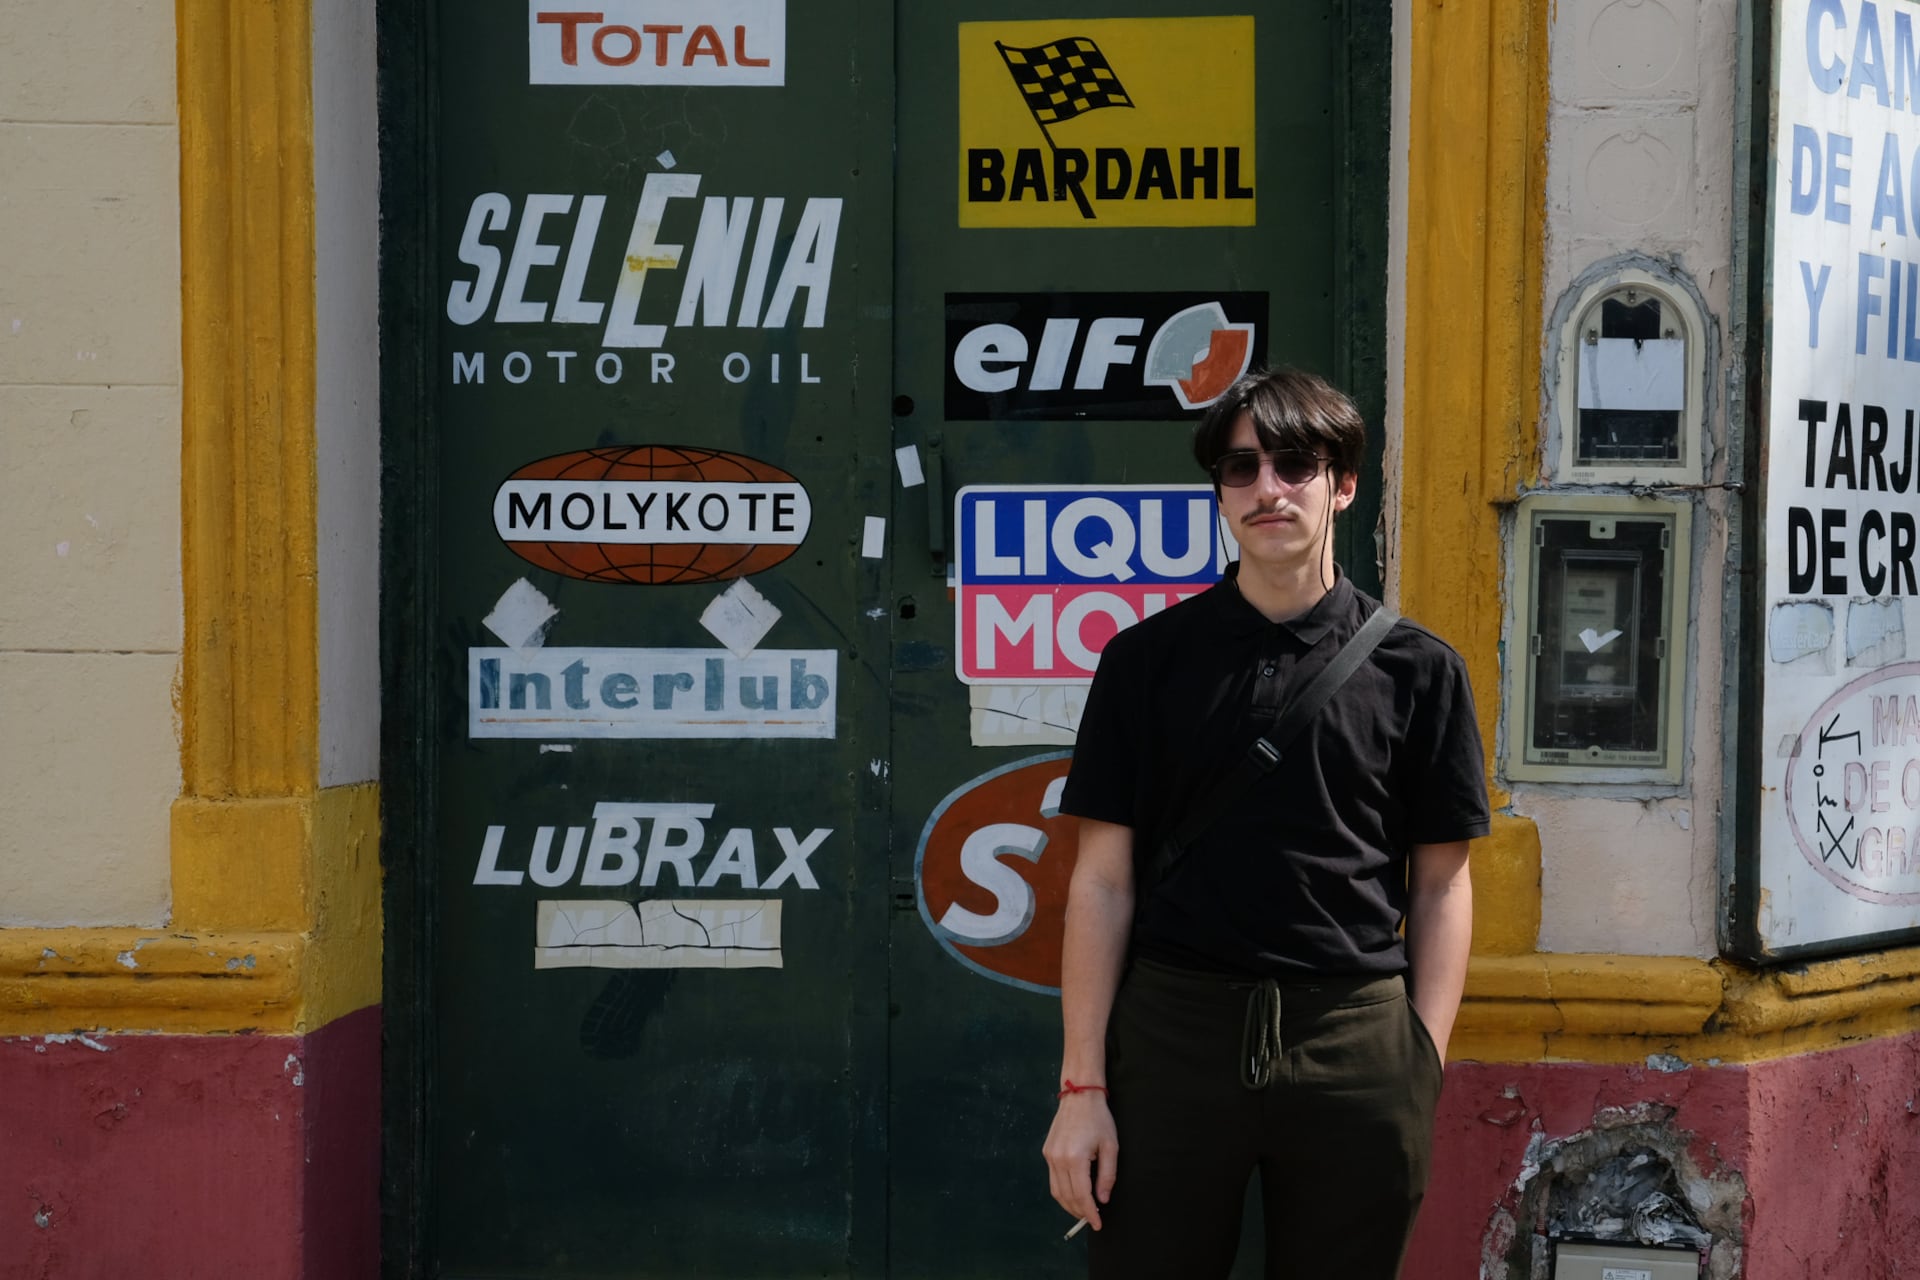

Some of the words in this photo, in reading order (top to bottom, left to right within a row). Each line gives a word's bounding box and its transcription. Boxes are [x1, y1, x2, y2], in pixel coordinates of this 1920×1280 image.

[537, 12, 770, 67] TOTAL
[968, 147, 1254, 219] BARDAHL
[1790, 123, 1853, 225] DE
[1871, 132, 1920, 240] A
[1799, 260, 1832, 349] Y
[1856, 252, 1920, 363] FIL
[452, 351, 675, 384] MOTOR
[722, 352, 821, 384] OIL
[954, 318, 1144, 393] elf
[1798, 398, 1920, 494] TARJ
[508, 491, 795, 532] MOLYKOTE
[1788, 506, 1848, 595] DE
[1858, 509, 1918, 596] CR
[976, 591, 1201, 671] MO
[479, 657, 830, 712] Interlub
[1844, 760, 1891, 814] DE
[472, 802, 834, 890] LUBRAX
